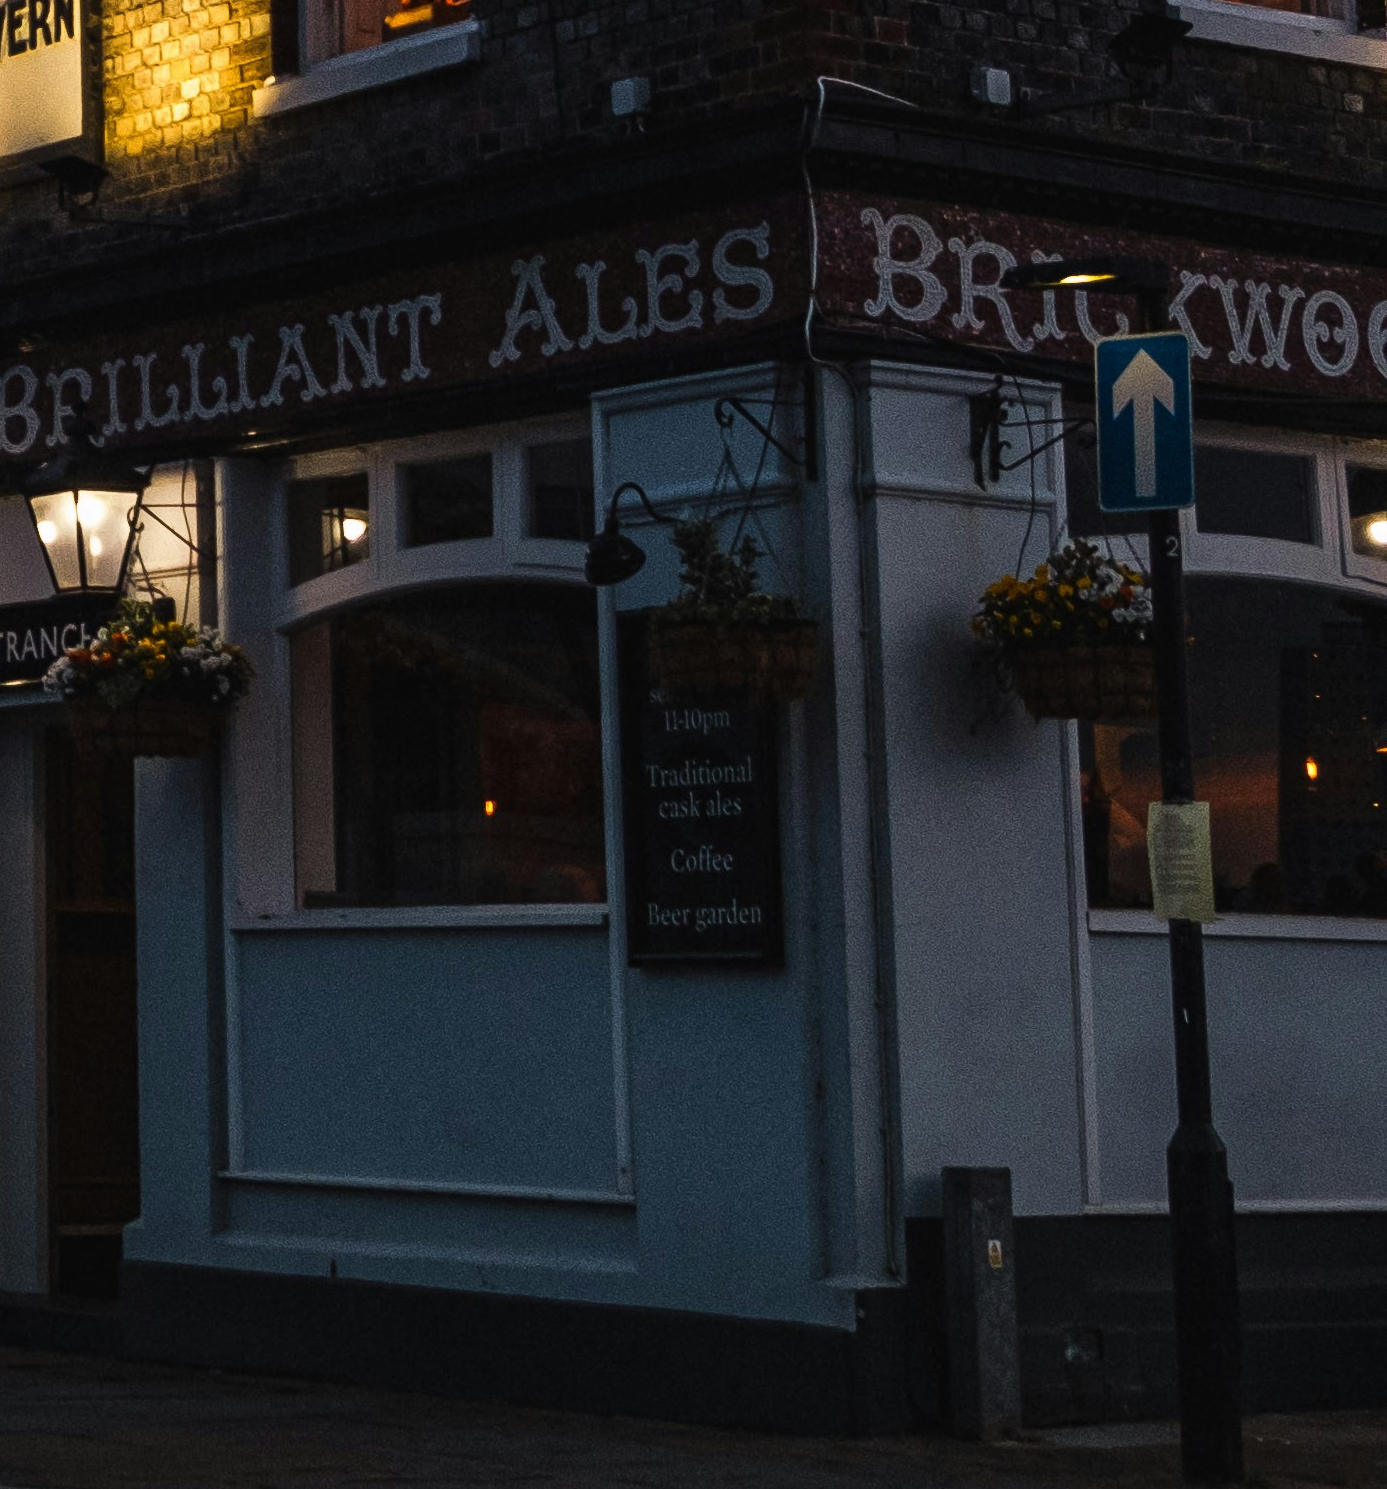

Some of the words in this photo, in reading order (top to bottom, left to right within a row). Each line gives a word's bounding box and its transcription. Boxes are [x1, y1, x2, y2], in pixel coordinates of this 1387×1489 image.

[487, 220, 775, 368] ALES
[1164, 534, 1179, 558] 2
[646, 755, 754, 788] Traditional
[657, 790, 701, 819] cask
[705, 789, 744, 817] ales
[670, 844, 733, 872] Coffee
[646, 902, 690, 926] Beer
[694, 896, 763, 933] garden
